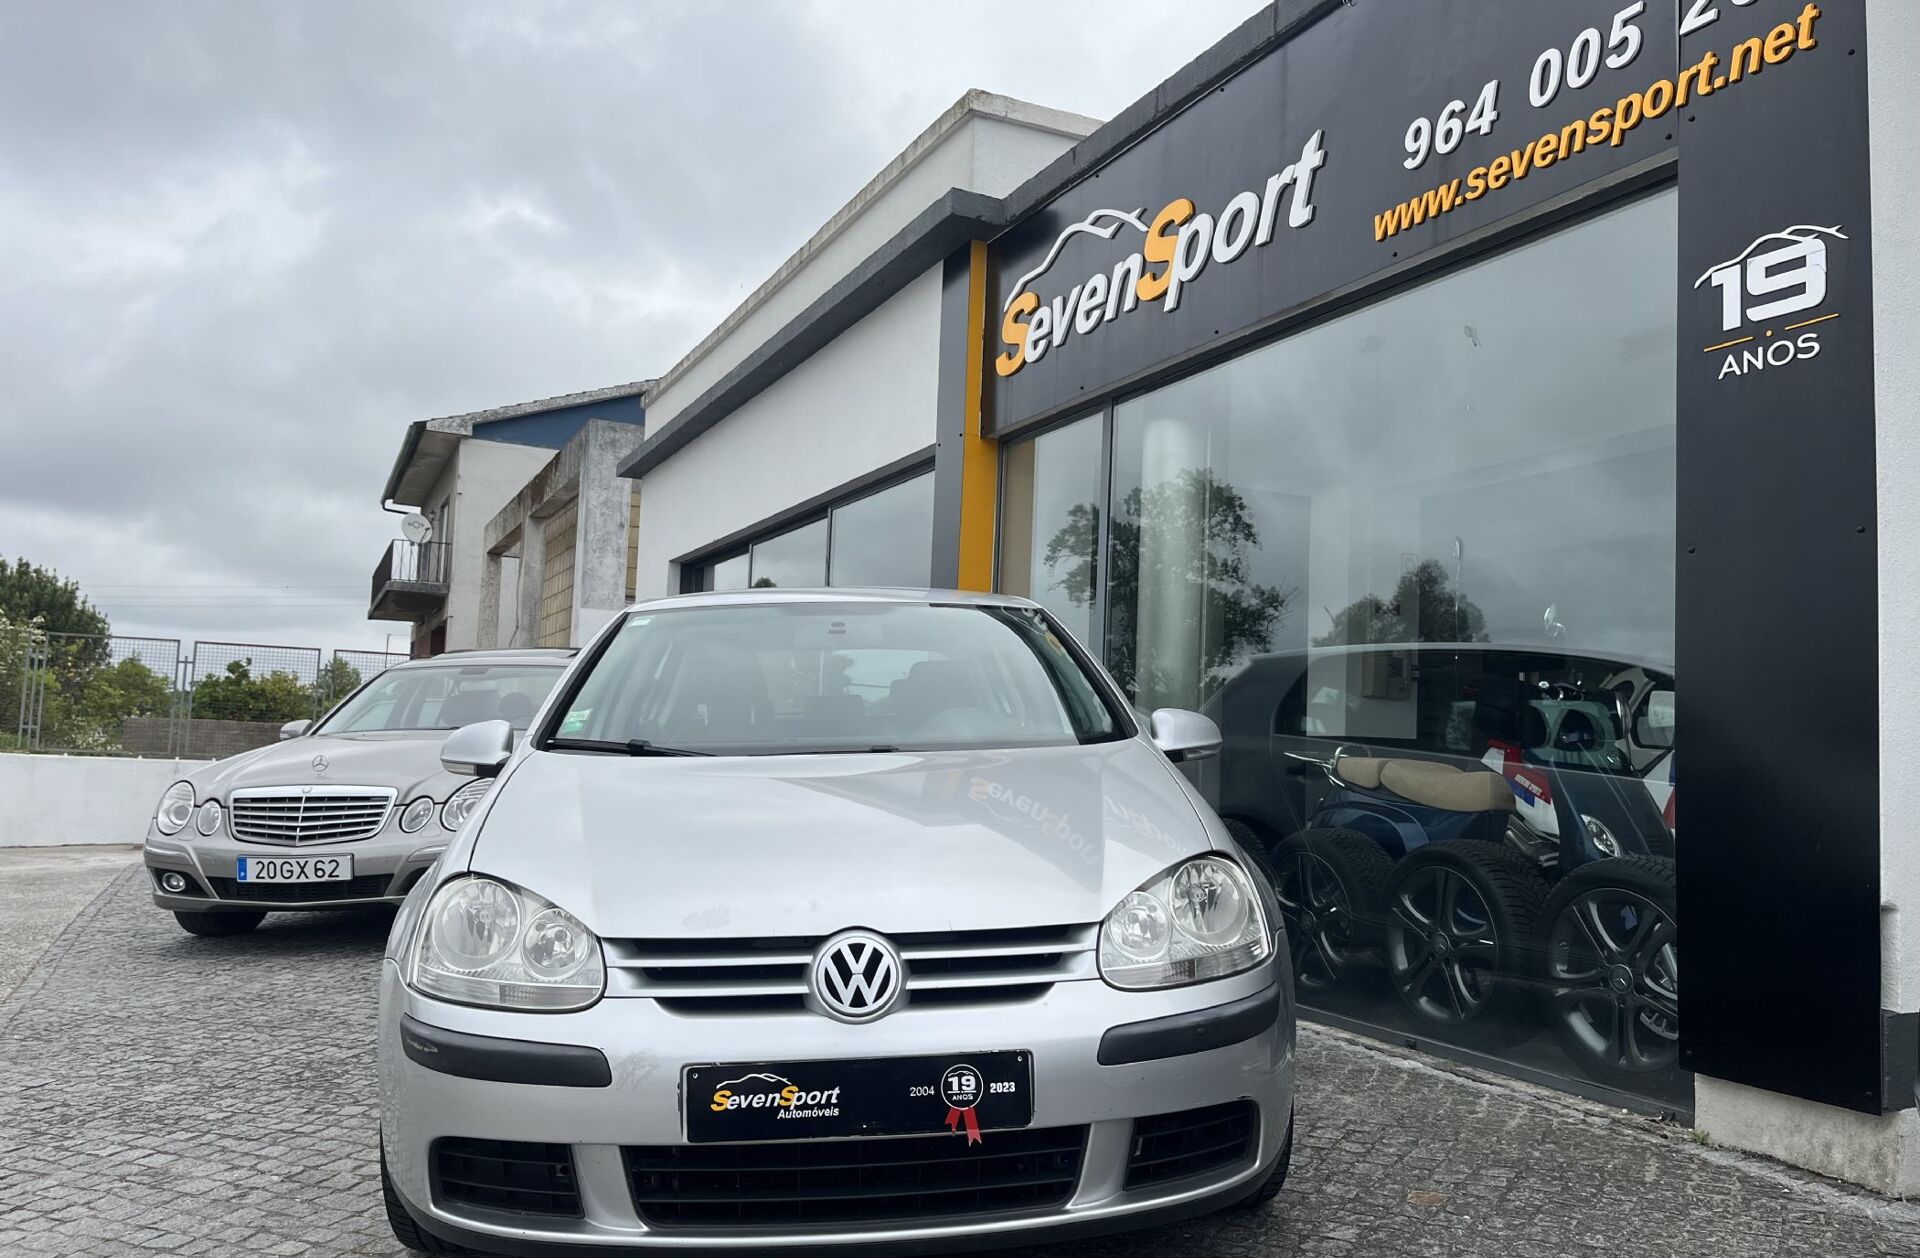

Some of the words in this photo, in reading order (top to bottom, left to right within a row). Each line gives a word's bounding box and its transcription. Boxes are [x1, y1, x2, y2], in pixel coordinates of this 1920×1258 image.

[1403, 80, 1499, 170] 964
[1529, 1, 1644, 108] 005
[1375, 3, 1819, 241] www.sevensport.net
[996, 129, 1326, 376] SevenSport
[1711, 238, 1826, 331] 19
[1718, 333, 1820, 380] ANOS
[710, 1086, 840, 1112] SevenSport
[910, 1086, 934, 1096] 2004
[990, 1082, 1015, 1093] 2023
[947, 1076, 976, 1091] 19
[777, 1106, 839, 1119] Automóveis
